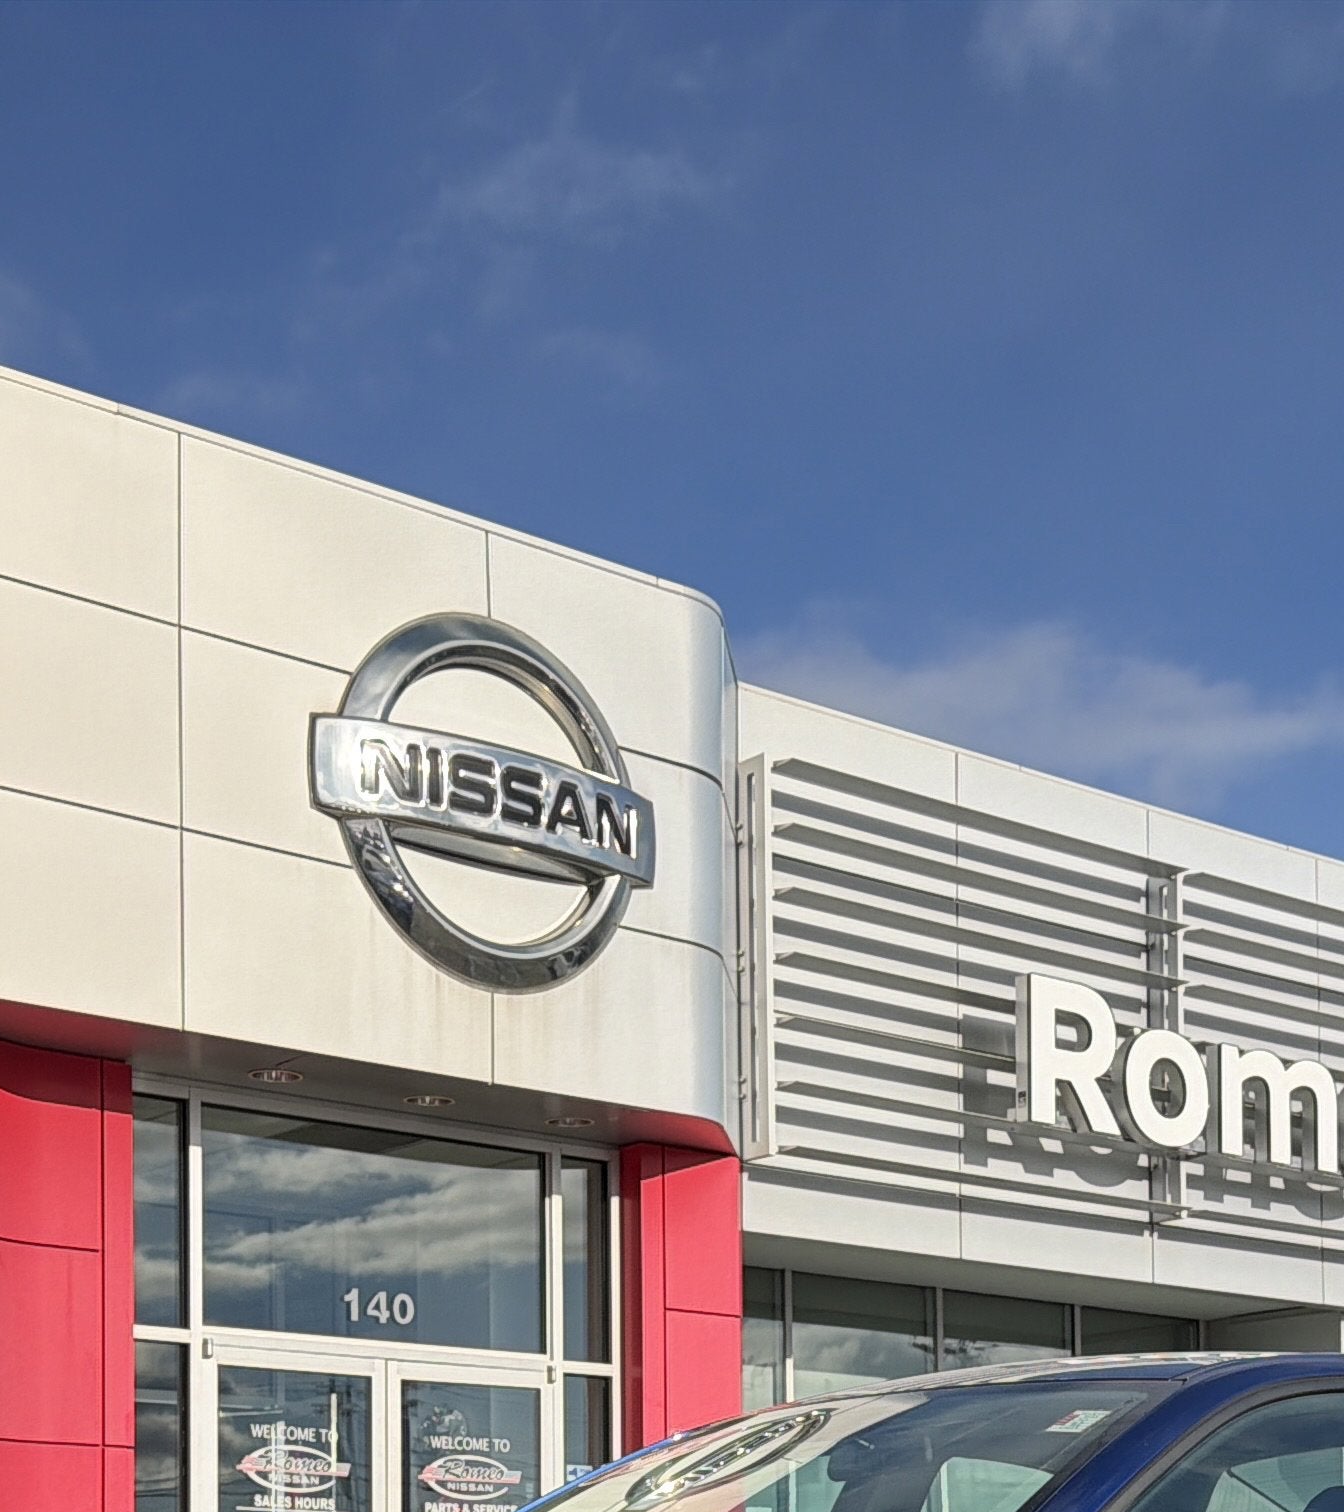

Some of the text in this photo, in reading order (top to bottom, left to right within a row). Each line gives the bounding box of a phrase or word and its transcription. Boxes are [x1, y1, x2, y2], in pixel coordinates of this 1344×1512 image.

[360, 737, 638, 861] NISSAN
[343, 1287, 415, 1325] 140
[249, 1423, 338, 1444] WELCOME TO
[429, 1435, 511, 1453] WELCOME TO
[263, 1449, 332, 1473] Romeo
[438, 1459, 505, 1480] Romeo
[267, 1473, 320, 1485] NISSAN
[446, 1482, 494, 1493] NISSAN
[254, 1494, 336, 1511] SALES HOURS
